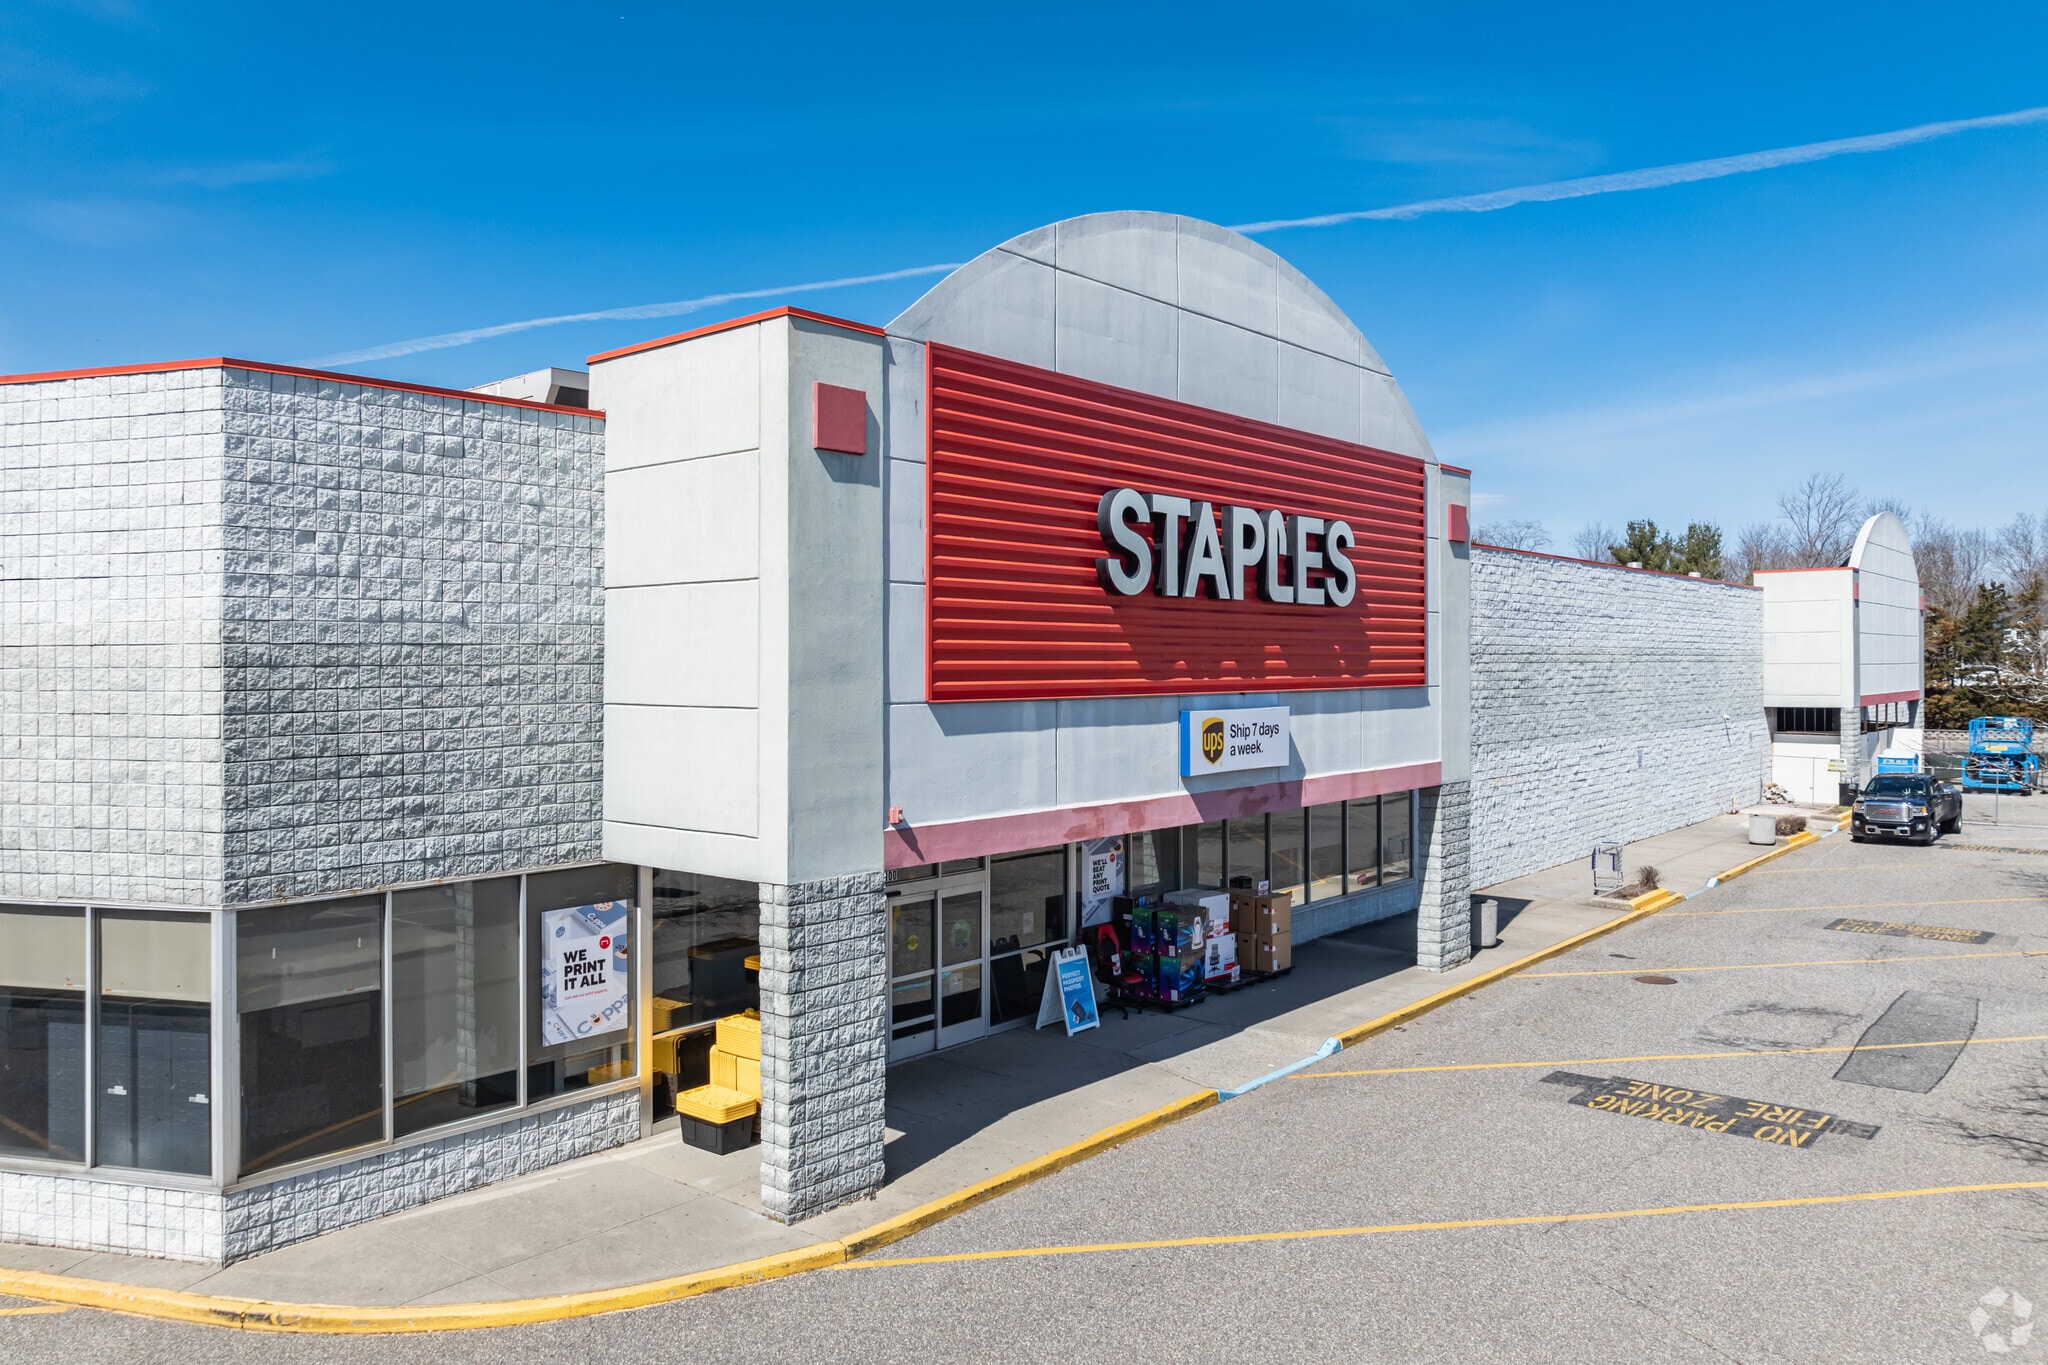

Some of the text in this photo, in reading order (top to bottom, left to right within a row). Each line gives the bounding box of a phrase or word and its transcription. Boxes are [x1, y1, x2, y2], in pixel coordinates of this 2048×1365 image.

[1097, 488, 1356, 607] STAPLES
[1230, 722, 1280, 740] Ship 7 days
[1230, 739, 1264, 756] a week.
[1092, 859, 1107, 867] WE'LL
[1092, 878, 1107, 886] PRINT
[1092, 884, 1110, 893] QUOTE
[563, 949, 587, 963] WE
[564, 959, 606, 977] PRINT
[564, 972, 606, 991] IT ALL
[1614, 1080, 1831, 1129] FIRE ZONE
[1588, 1095, 1737, 1133] PARKING
[1753, 1125, 1811, 1147] NO
